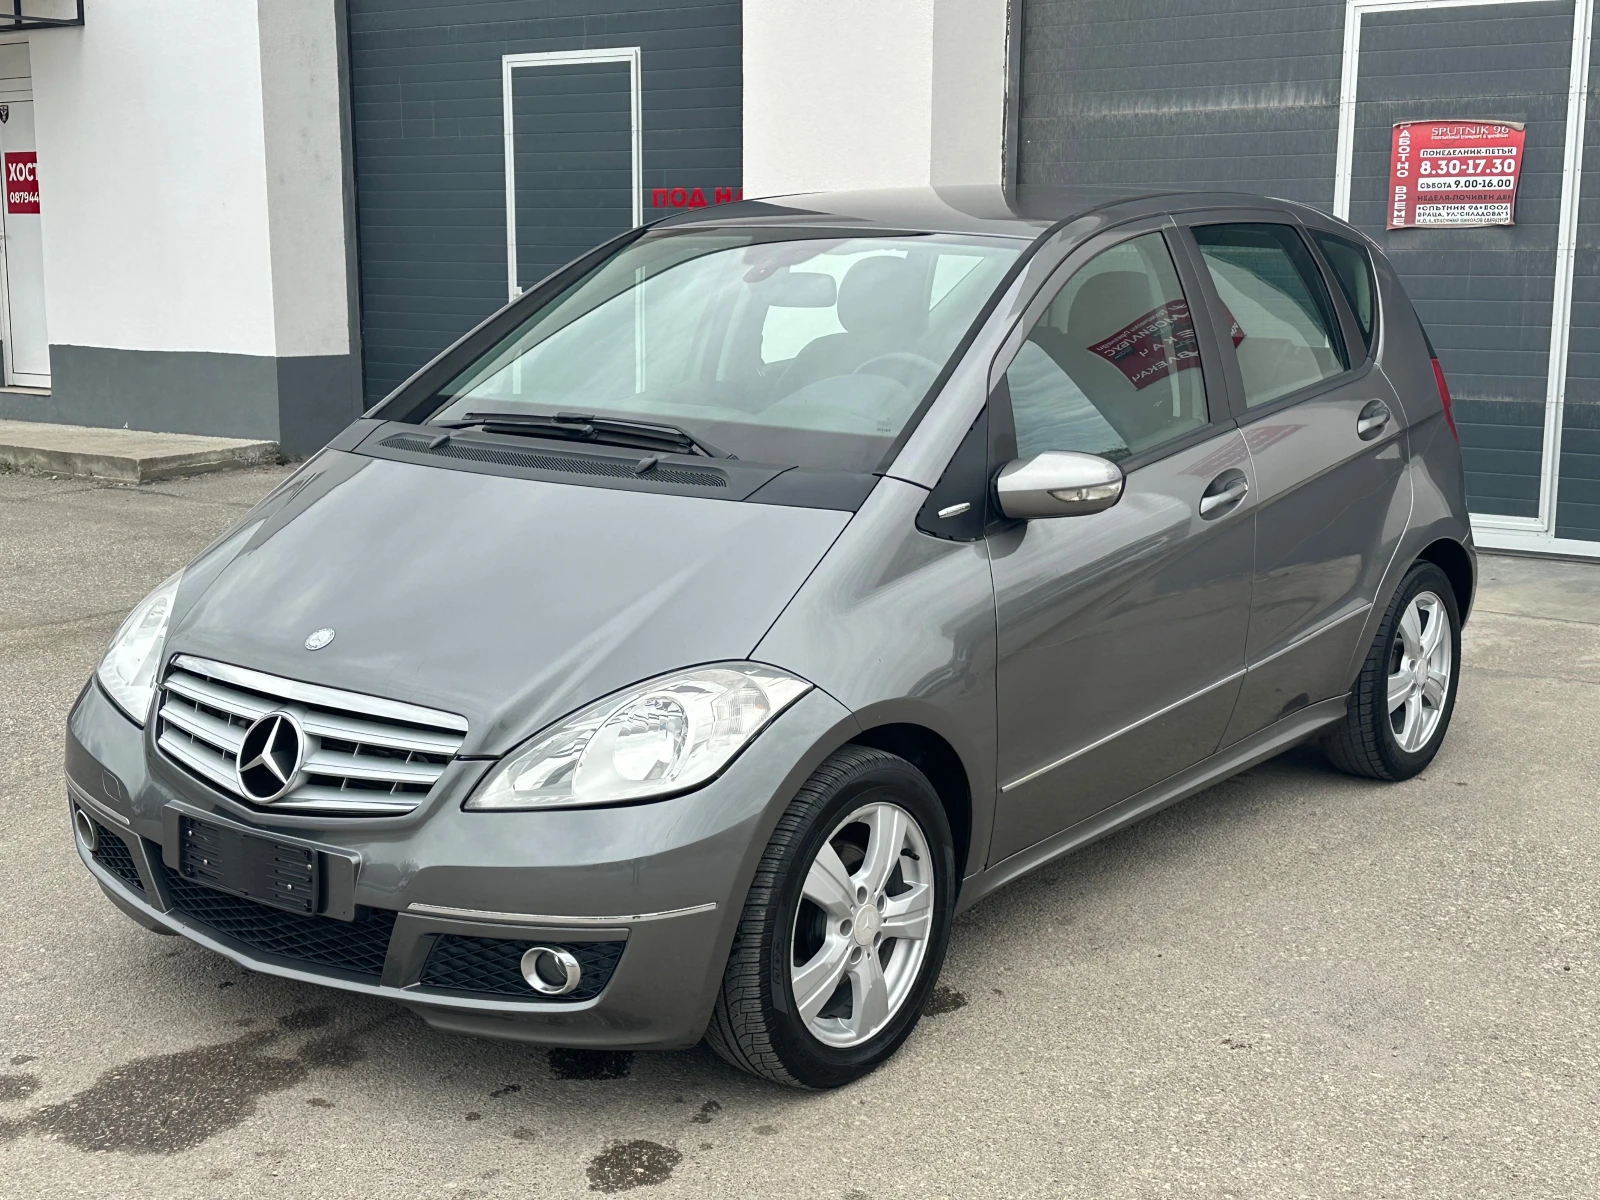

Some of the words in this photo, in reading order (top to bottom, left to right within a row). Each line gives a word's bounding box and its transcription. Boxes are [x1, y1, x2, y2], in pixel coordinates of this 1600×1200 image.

[1431, 126, 1489, 135] SPUTNIK
[1493, 125, 1509, 134] 96
[1422, 148, 1514, 157] ПОНЕДЕЛНИК-ПЕТЪК
[1420, 159, 1516, 174] 8.30-17.30
[1454, 179, 1512, 189] 9.00-16.00
[652, 187, 707, 210] ПОД
[1417, 194, 1494, 202] НЕДЕЛЯ-ПОЧИВЕН
[1392, 186, 1407, 225] ВРЕМЕ
